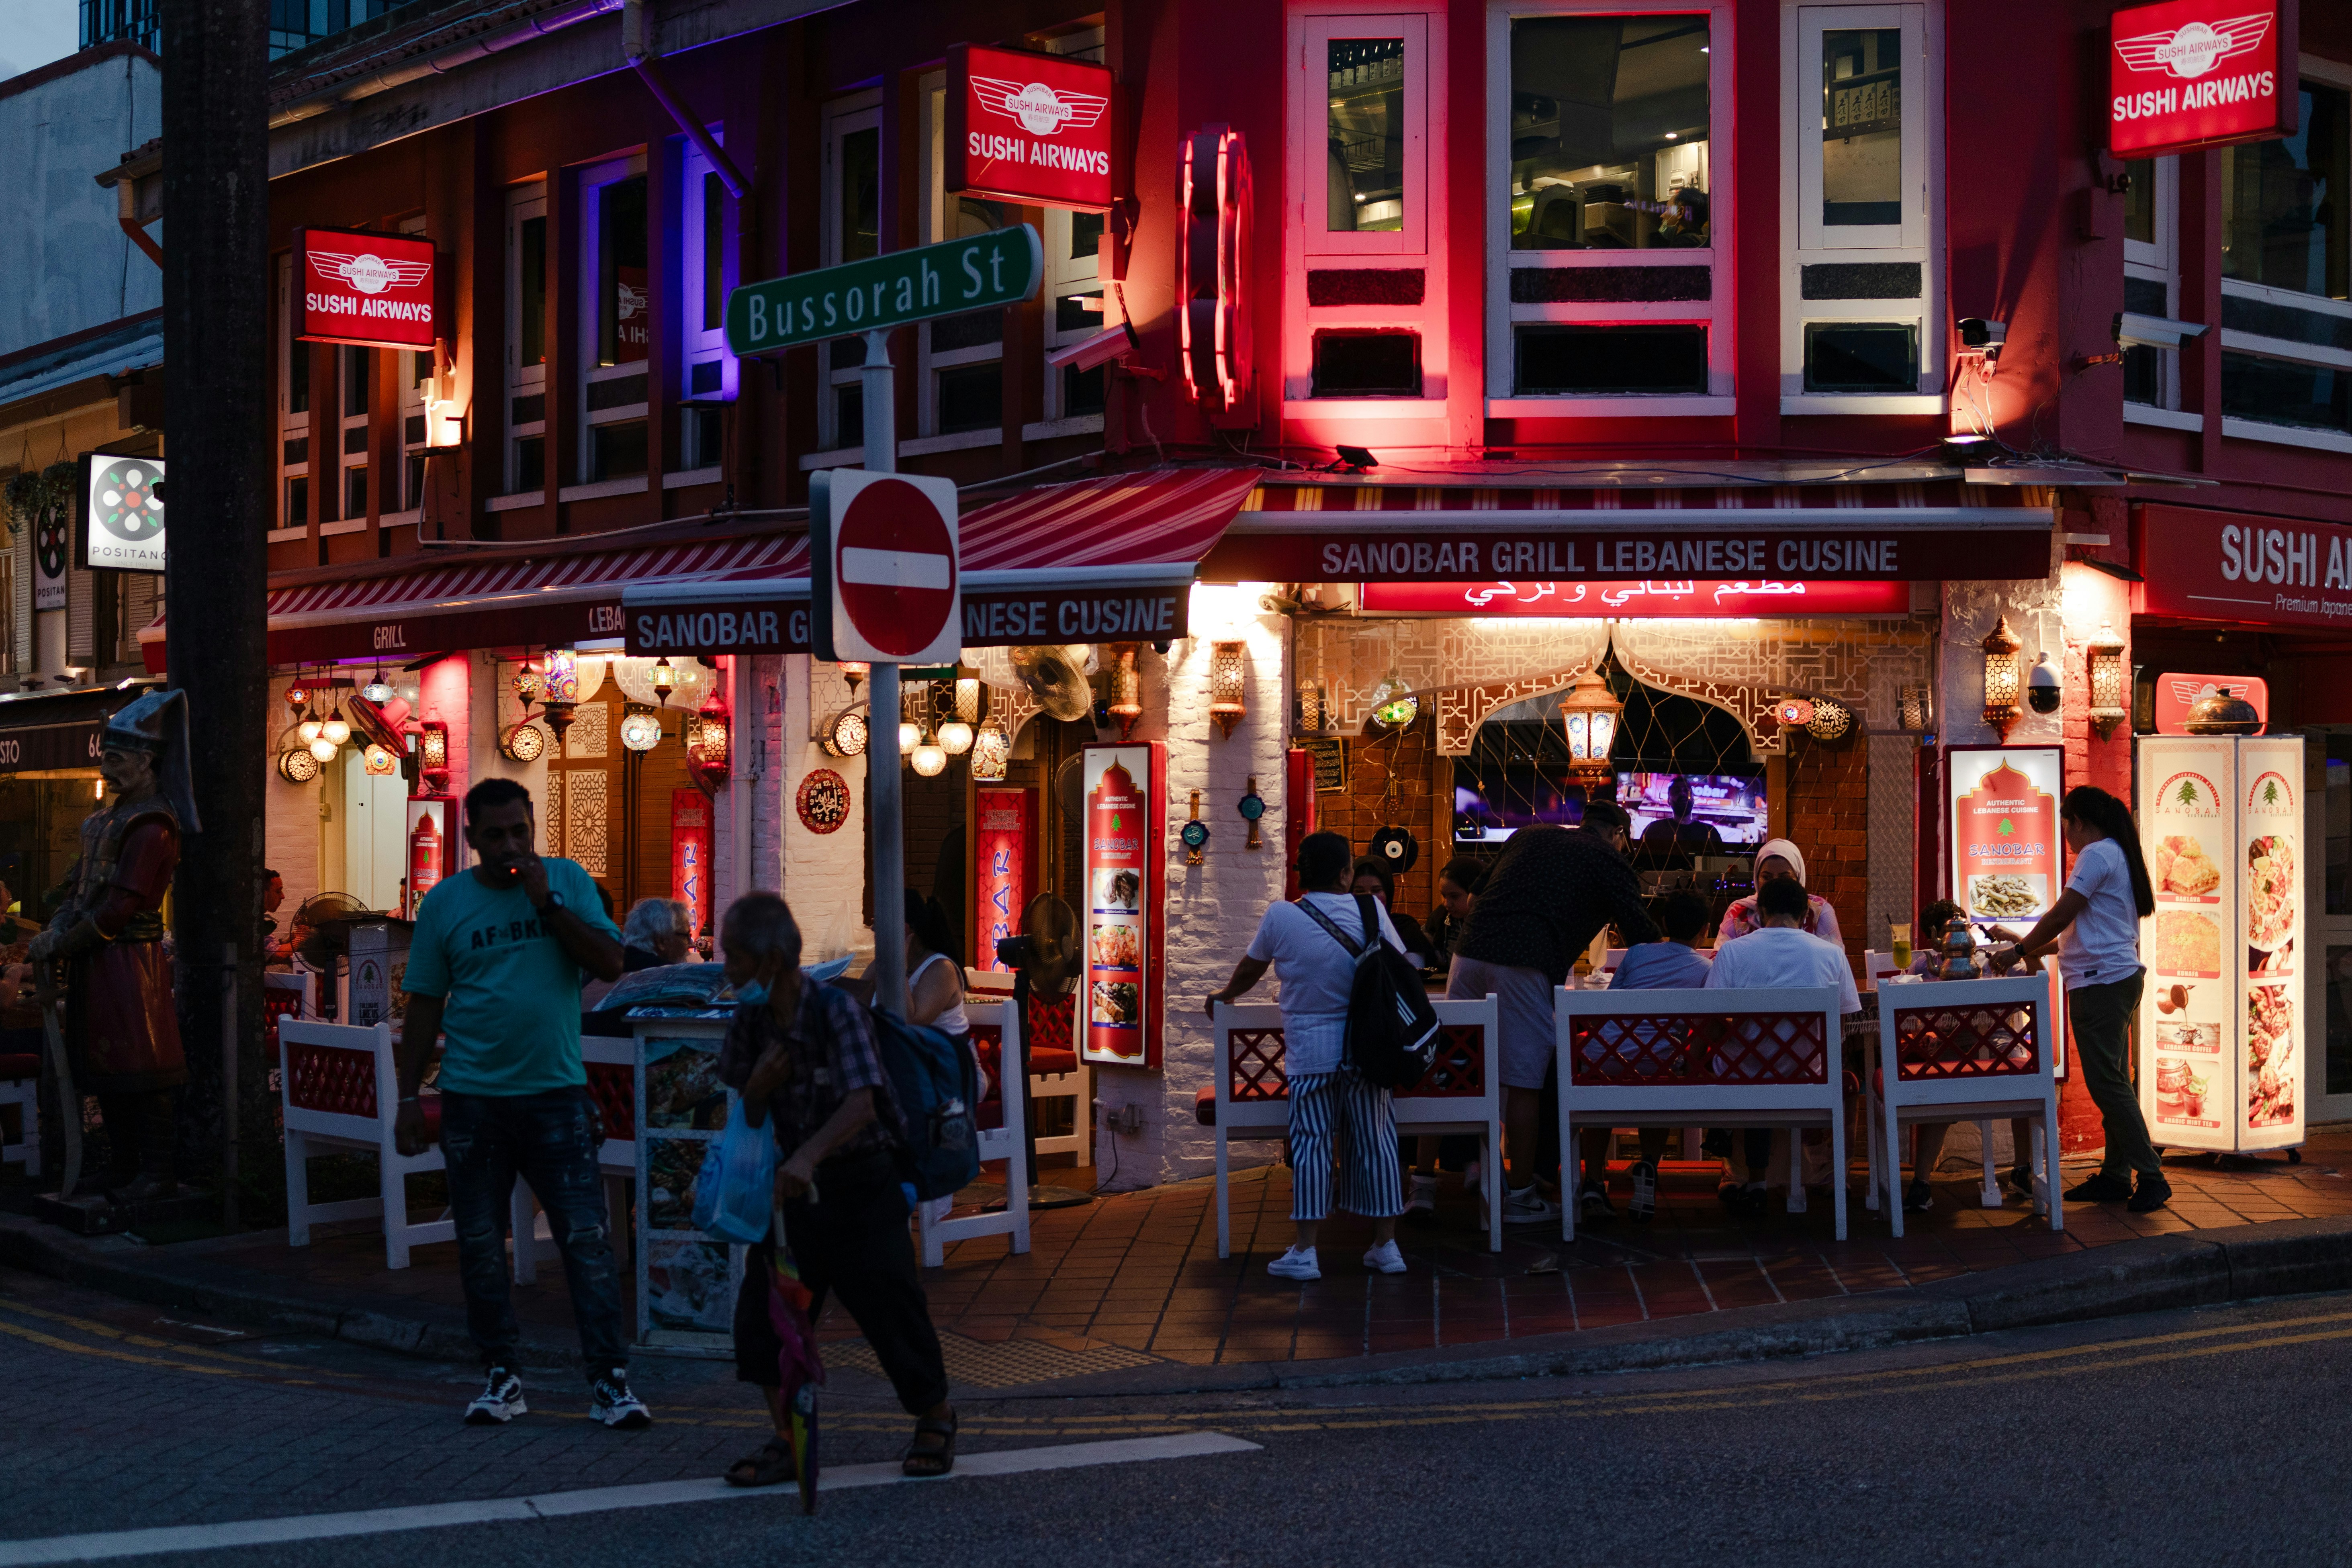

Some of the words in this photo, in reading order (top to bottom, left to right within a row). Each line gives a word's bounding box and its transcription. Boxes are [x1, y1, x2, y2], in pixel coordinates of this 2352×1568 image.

[2178, 25, 2208, 39] SUSHIBAR
[2158, 45, 2186, 60] SUSHI
[2188, 37, 2229, 52] AIRWAYS
[1027, 85, 1052, 98] SUSHIBAR
[2113, 87, 2176, 121] SUSHI
[2182, 70, 2274, 110] AIRWAYS
[1008, 98, 1033, 111] SUSHI
[1035, 102, 1069, 117] AIRWAYS
[969, 131, 1025, 163] SUSHI
[1030, 141, 1109, 175] AIRWAYS
[342, 266, 364, 276] SUSHI
[366, 270, 397, 279] AIRWAYS
[358, 256, 381, 266] SUSHIBAR
[749, 258, 940, 342] Bussorah
[963, 245, 1005, 298] St
[307, 292, 357, 315] SUSHI
[361, 298, 432, 322] AIRWAYS
[1322, 542, 1479, 574] SANOBAR
[1491, 541, 1585, 572] GRILL
[1596, 541, 1766, 572] LEBANESE
[1777, 540, 1898, 572] CUSINE
[2221, 524, 2316, 587] SUSHI
[2274, 593, 2318, 613] Premium
[589, 605, 626, 633] LEBA
[637, 611, 780, 648] SANOBAR
[960, 601, 1047, 638] NESE
[1058, 597, 1176, 636] CUSINE
[374, 624, 407, 650] GRILL
[1094, 838, 1139, 850] SANOBAR
[1969, 843, 2045, 857] SANOBAR
[2164, 1044, 2191, 1052] LEBANESE
[2192, 1045, 2212, 1053] COFFEE
